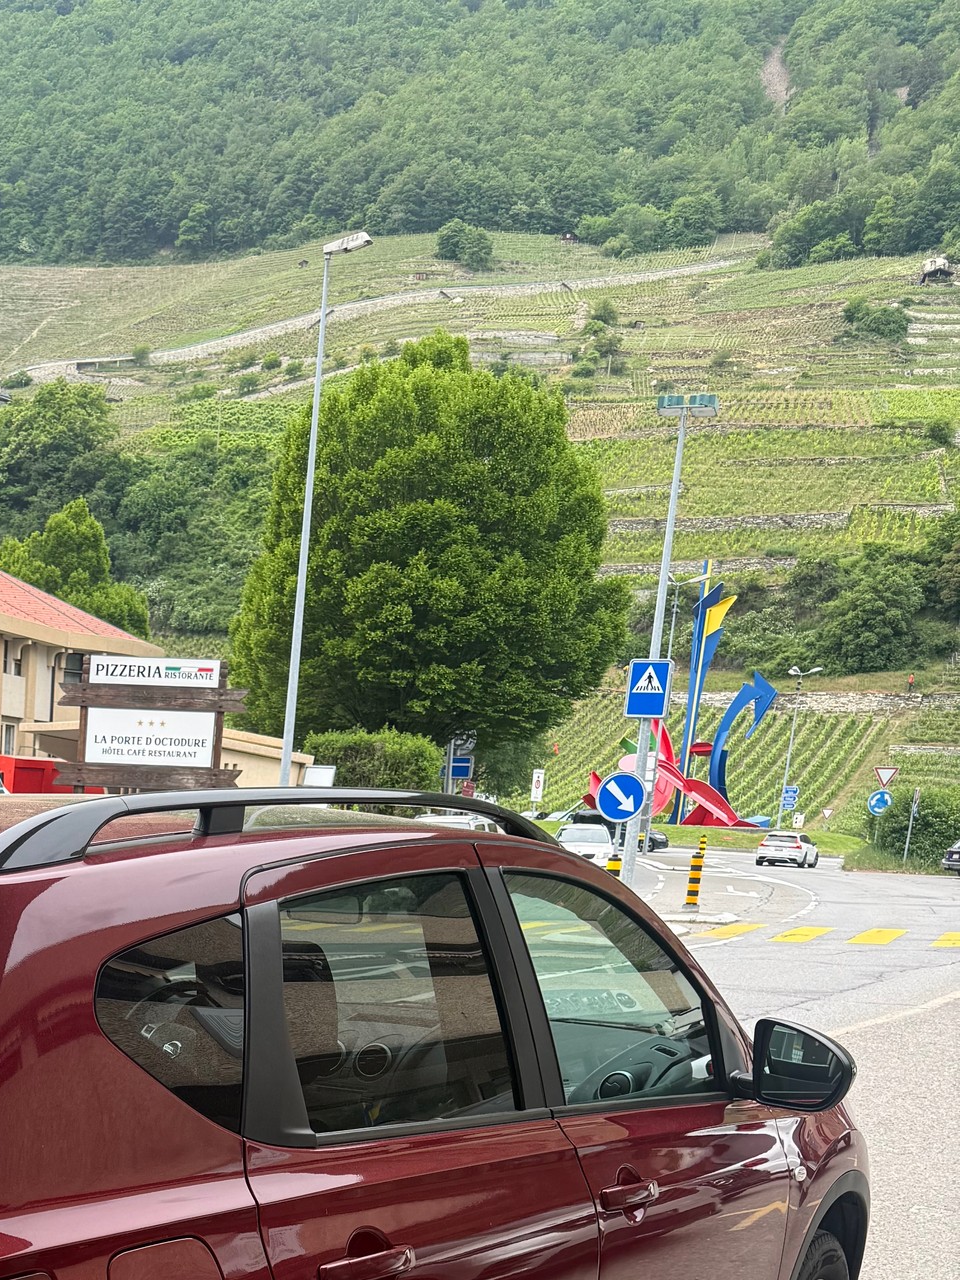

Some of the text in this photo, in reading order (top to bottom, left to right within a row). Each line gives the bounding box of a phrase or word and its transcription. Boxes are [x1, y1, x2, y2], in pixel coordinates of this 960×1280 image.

[95, 663, 214, 681] PIZZERIA RISTORANTE
[94, 734, 107, 744] LA
[110, 735, 143, 746] PORTE
[101, 746, 197, 759] HÔTEL CAFÉ RESTAURANT
